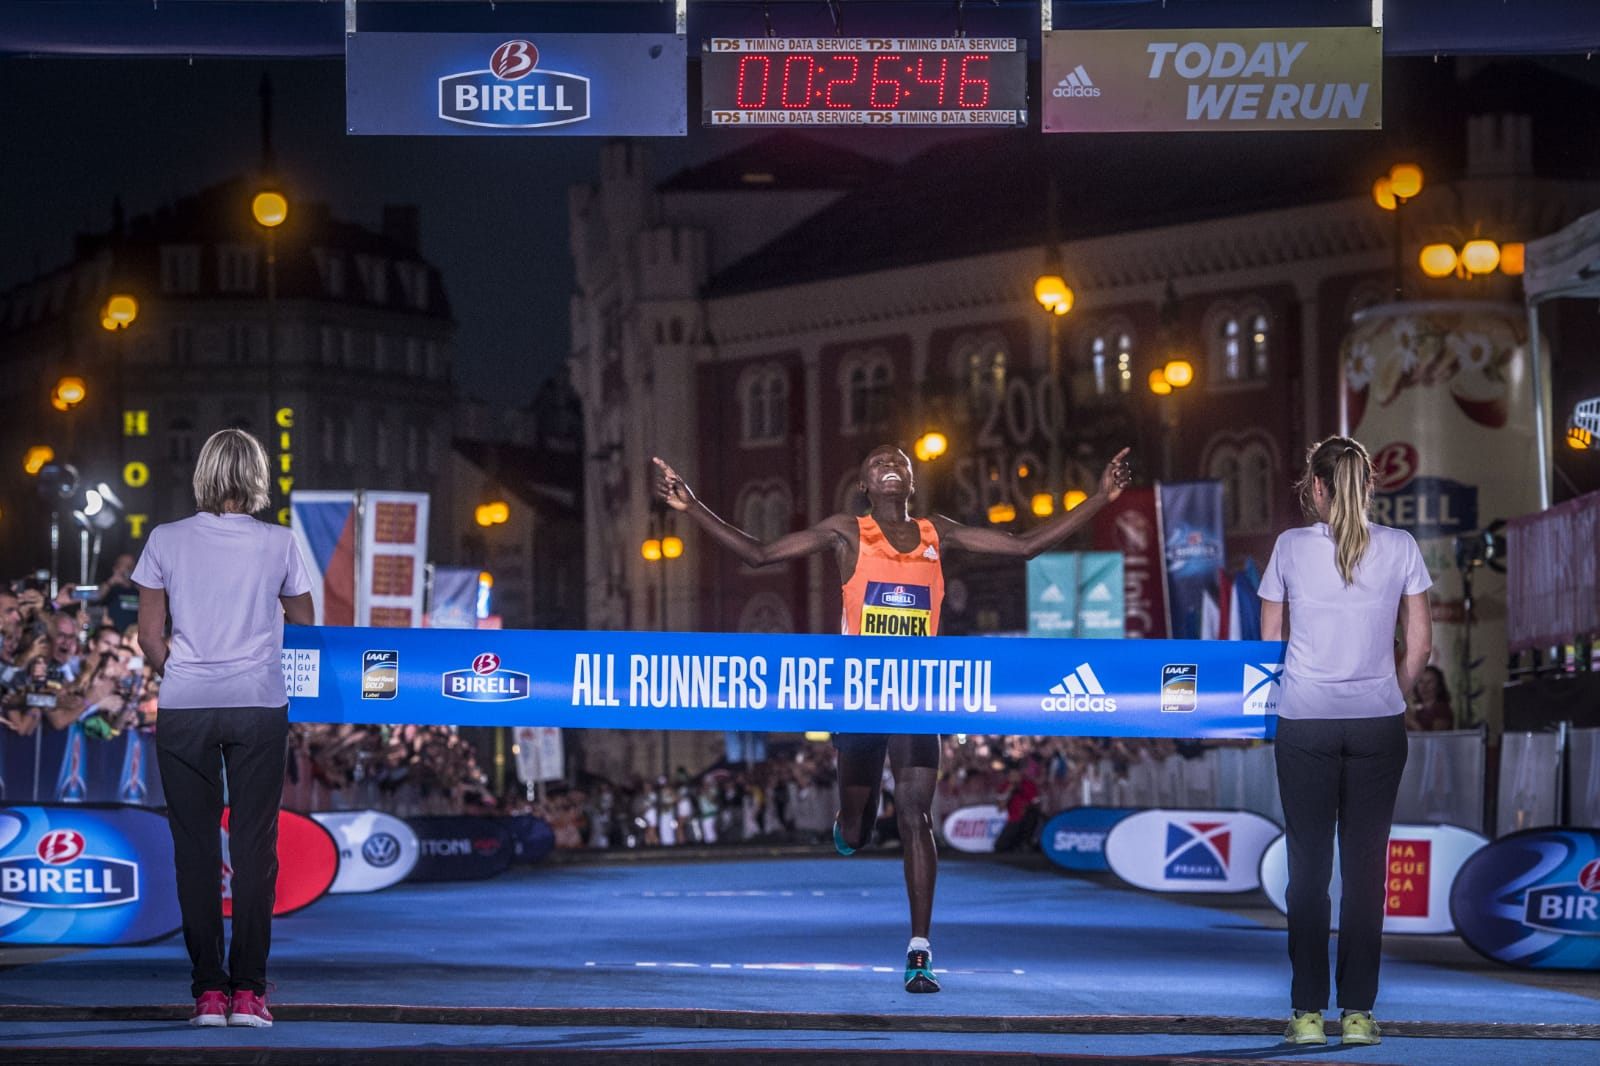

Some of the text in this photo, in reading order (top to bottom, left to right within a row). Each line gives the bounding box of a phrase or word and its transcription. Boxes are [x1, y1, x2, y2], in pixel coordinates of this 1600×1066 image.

[714, 40, 740, 50] TDS
[745, 40, 785, 50] TIMING
[789, 40, 813, 50] DATA
[817, 40, 861, 50] SERVICE
[898, 40, 937, 50] TIMING
[941, 40, 965, 50] DATA
[969, 40, 1014, 50] SERVICE
[1146, 41, 1308, 79] TODAY
[737, 55, 990, 108] 00:26:46
[1052, 85, 1100, 97] adidas
[455, 85, 573, 111] BIRELL
[1186, 83, 1369, 121] WE RUN
[714, 112, 741, 122] TDS
[745, 112, 785, 122] TIMING
[789, 112, 813, 122] DATA
[817, 112, 861, 122] SERVICE
[898, 112, 937, 122] TIMING
[941, 112, 965, 122] DATA
[969, 112, 1014, 122] SERVICE
[276, 407, 294, 495] CITY
[865, 613, 927, 636] RHONEX
[452, 677, 520, 694] BIRELL
[571, 653, 997, 713] ALL RUNNERS ARE BEAUTIFUL
[1041, 693, 1117, 712] adidas
[1391, 845, 1415, 858] HA
[1390, 861, 1425, 875] GUE
[2, 868, 122, 893] BIRELL
[1389, 878, 1414, 891] GA
[1388, 895, 1401, 909] G
[1540, 894, 1599, 920] BIR
